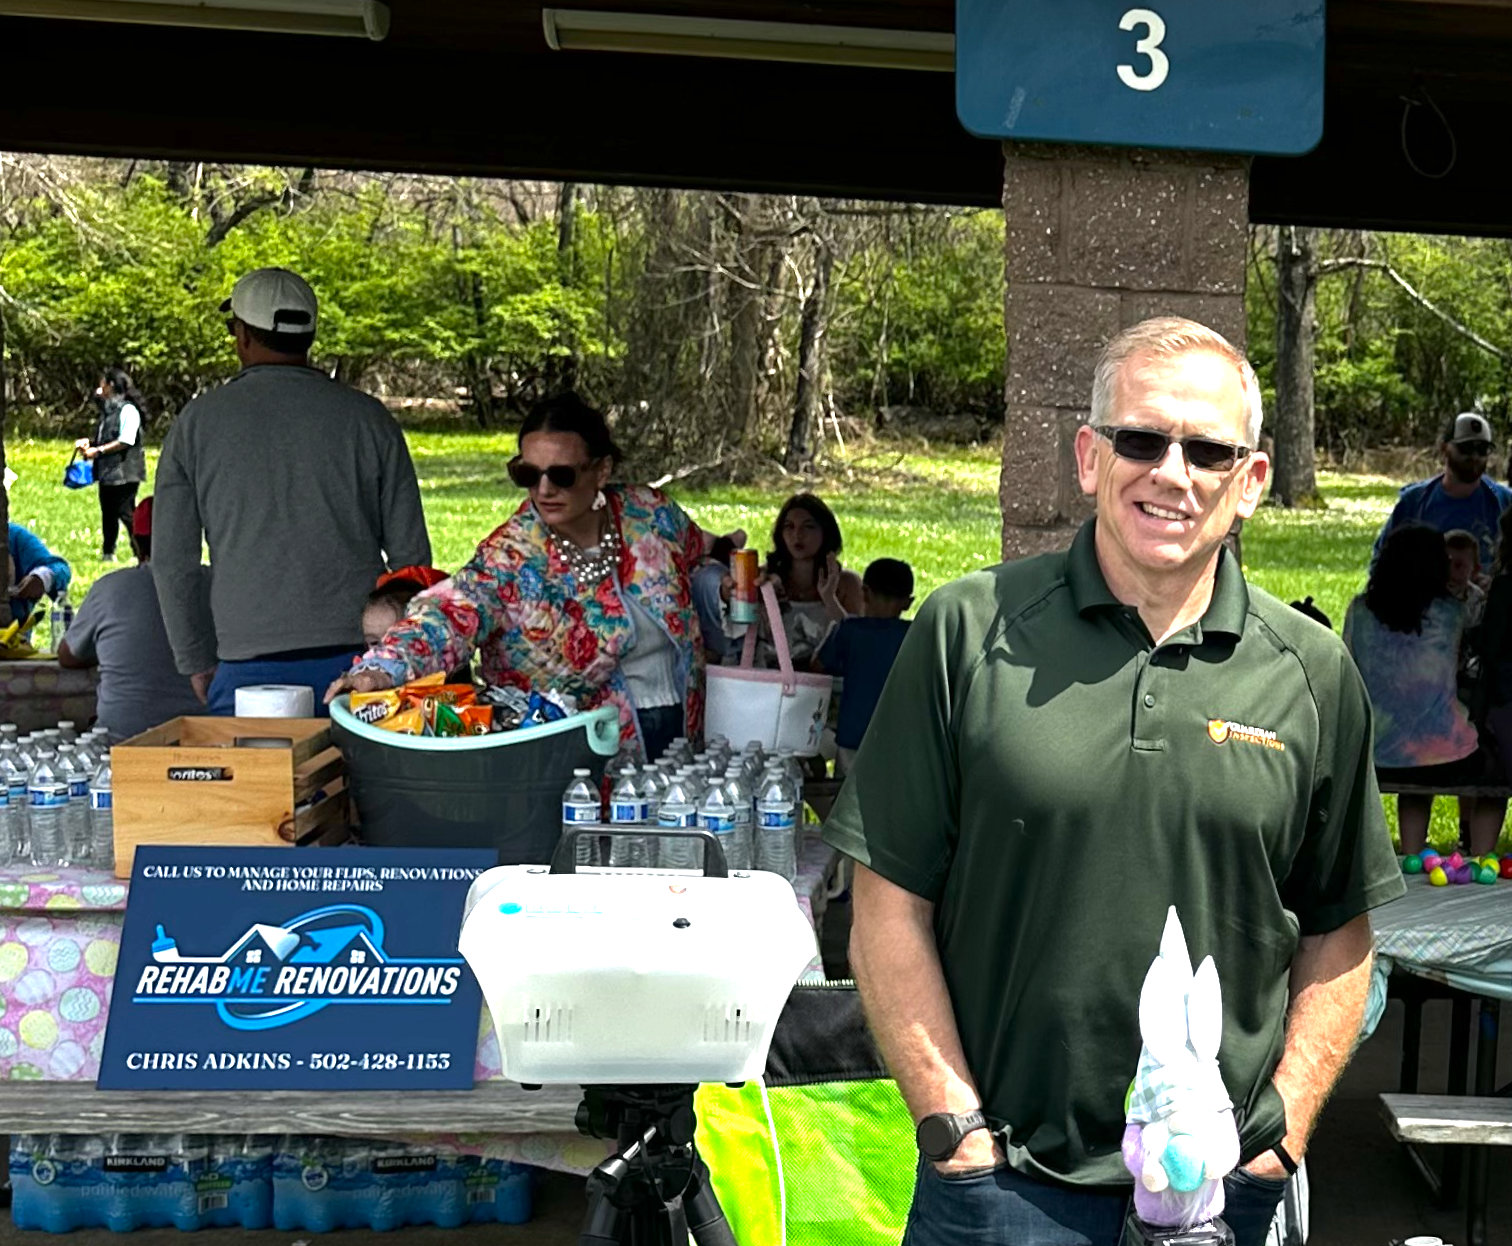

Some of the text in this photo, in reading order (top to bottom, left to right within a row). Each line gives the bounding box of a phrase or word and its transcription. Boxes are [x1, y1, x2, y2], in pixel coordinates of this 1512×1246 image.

[1116, 8, 1170, 91] 3
[143, 866, 484, 880] CALL US TO MANAGE YOUR FLIPS, RENOVATIONS
[241, 880, 384, 892] AND HOME REPAIRS
[135, 966, 461, 995] REHABME RENOVATIONS
[126, 1052, 198, 1070] CHRIS
[202, 1052, 291, 1070] ADKINS
[106, 1156, 166, 1168] KIRKLAND
